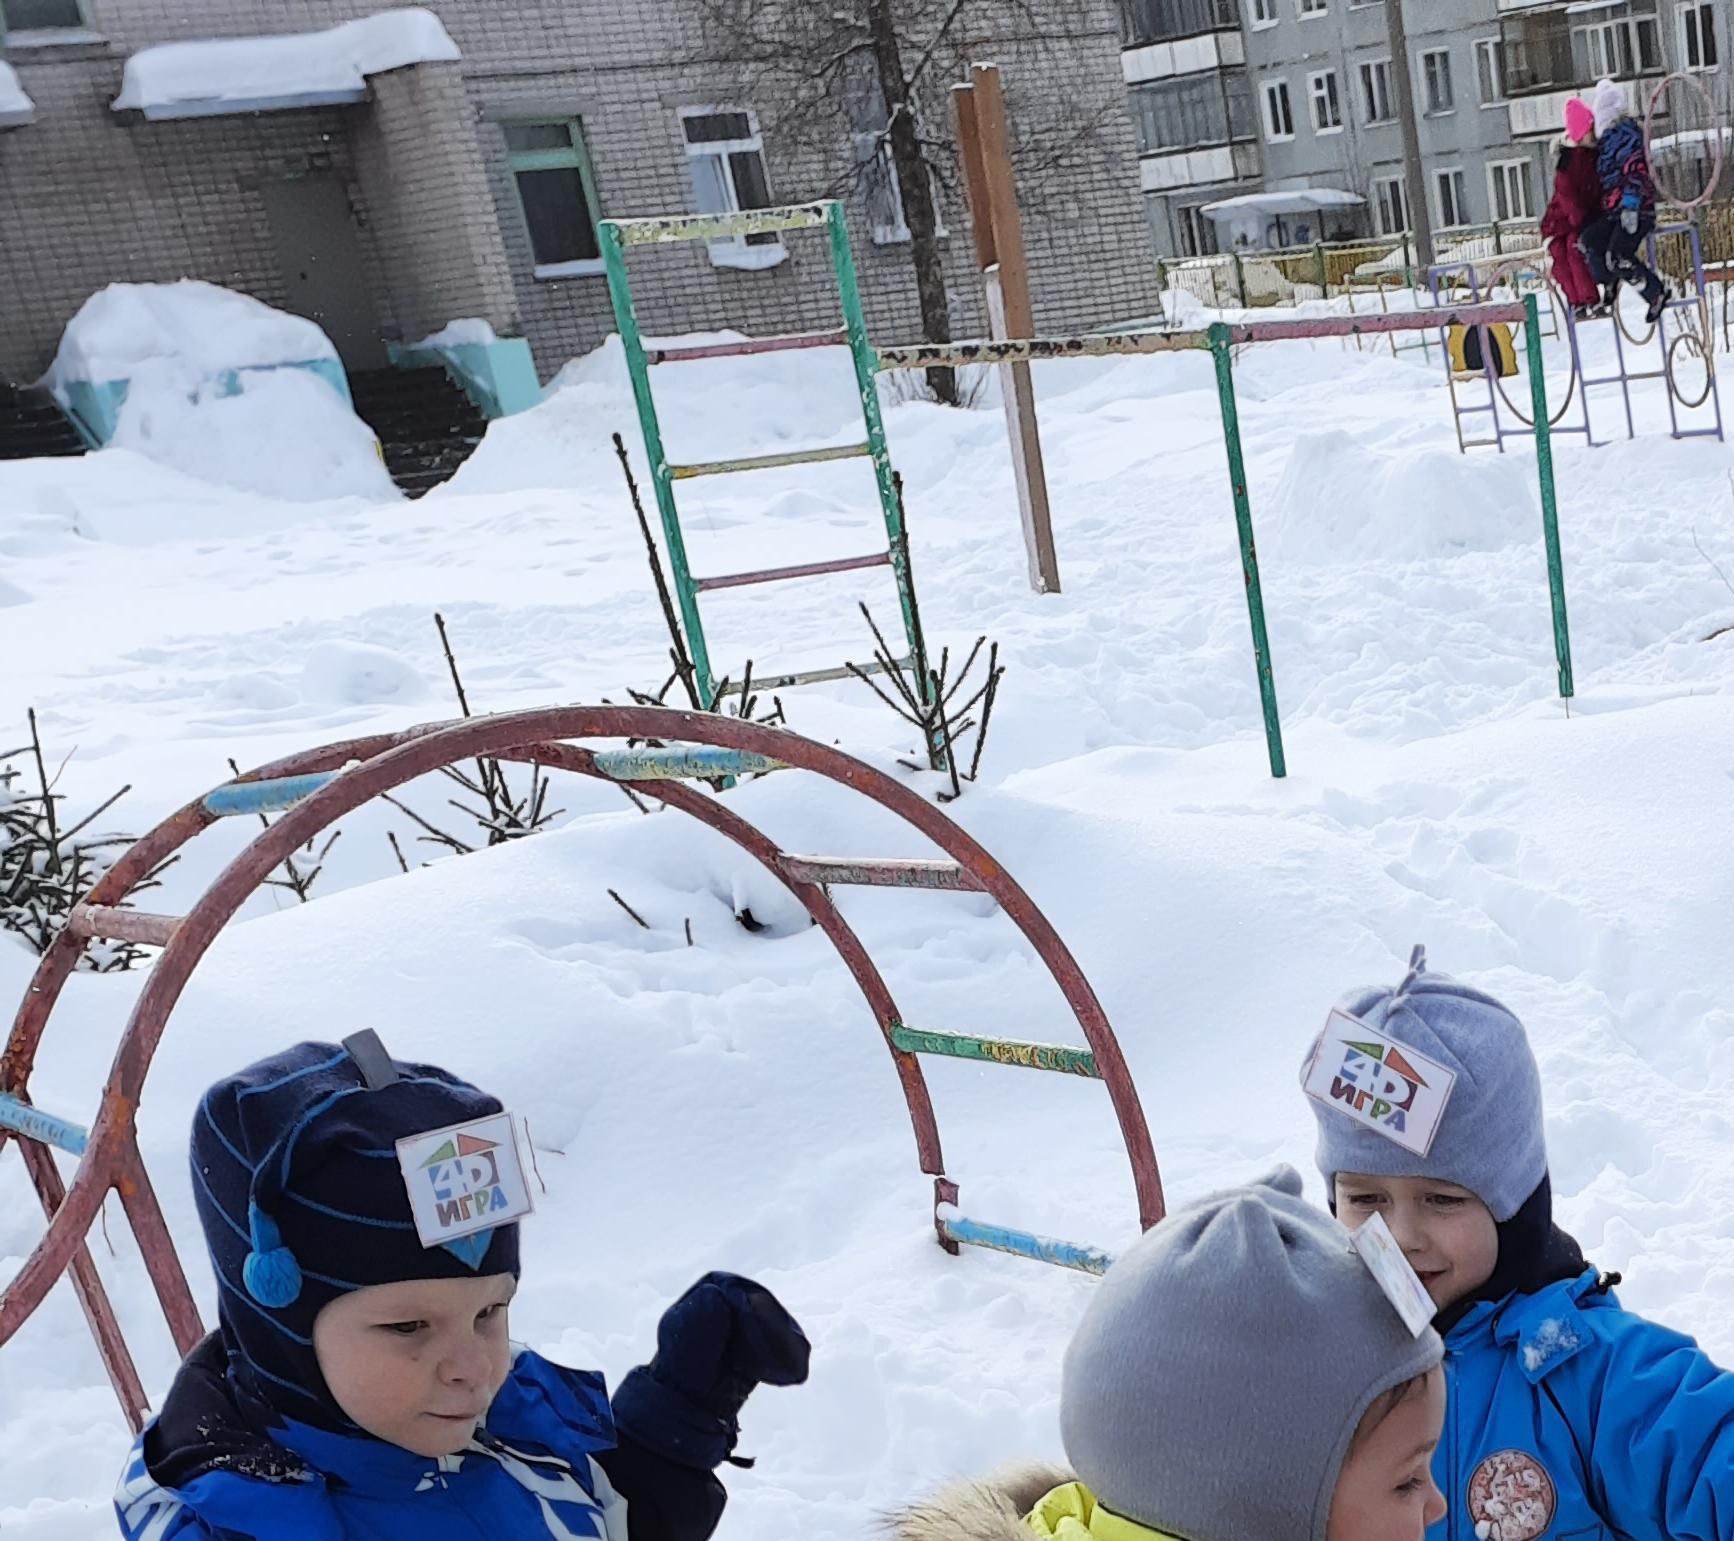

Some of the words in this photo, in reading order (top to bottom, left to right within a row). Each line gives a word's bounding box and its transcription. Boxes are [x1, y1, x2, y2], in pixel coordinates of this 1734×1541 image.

[1330, 1076, 1407, 1133] ИГРА
[1339, 1048, 1418, 1113] 4D
[435, 1184, 509, 1228] ИГРА
